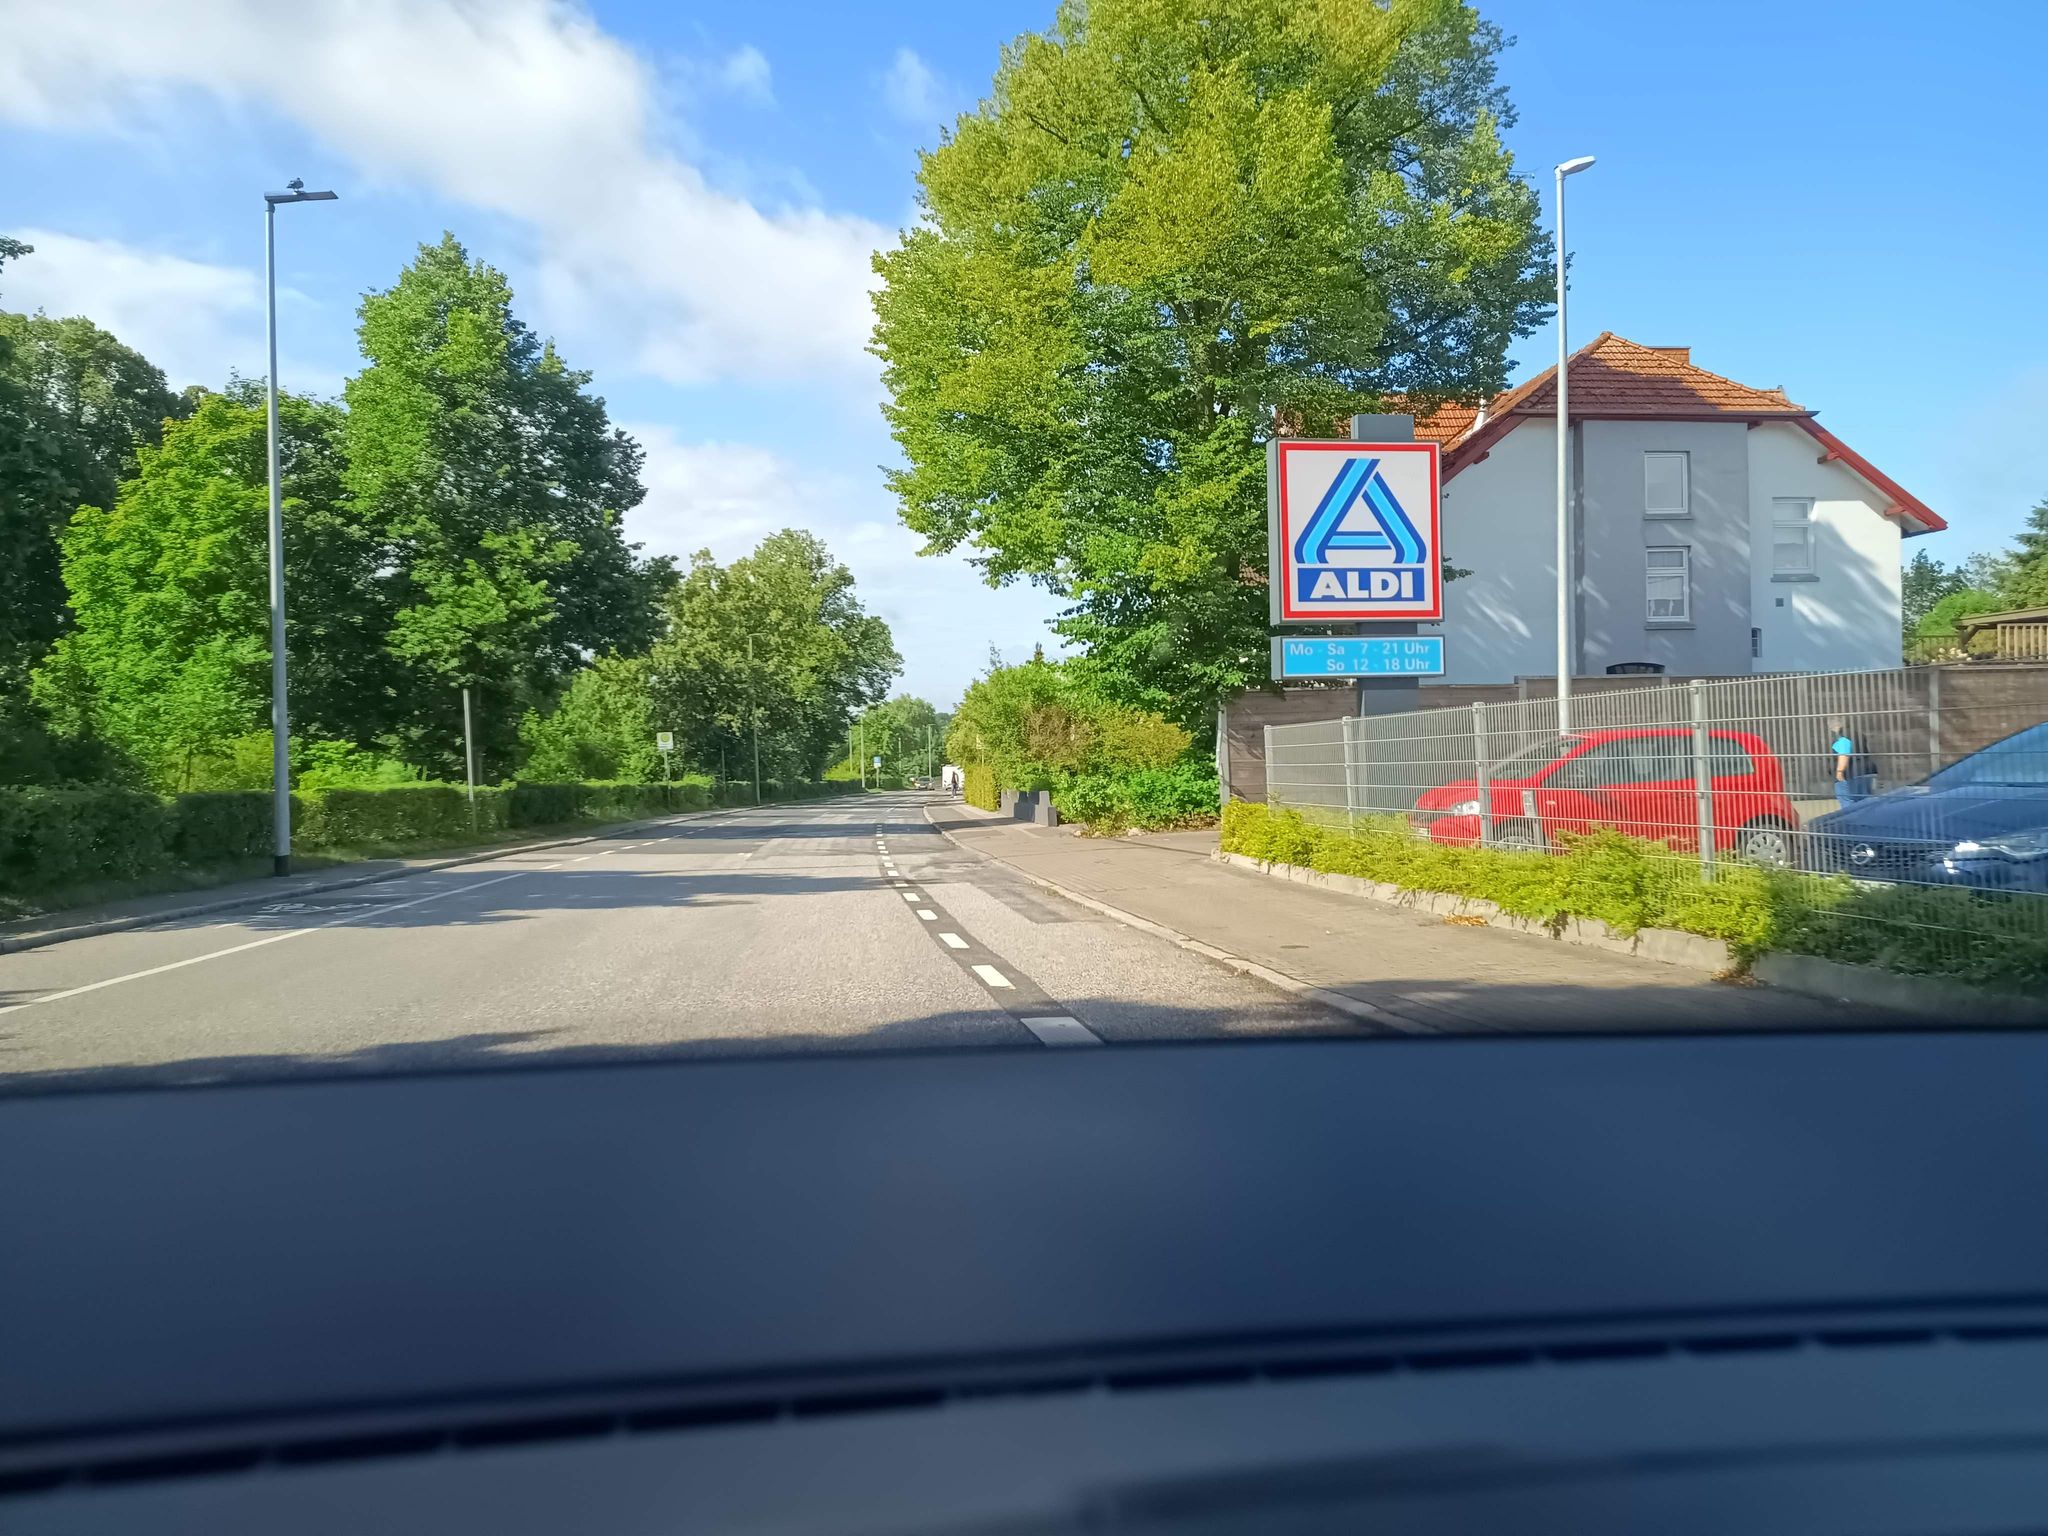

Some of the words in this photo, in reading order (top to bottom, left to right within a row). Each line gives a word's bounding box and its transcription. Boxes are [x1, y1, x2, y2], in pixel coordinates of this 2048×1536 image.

[1309, 571, 1414, 599] ALDI
[1290, 643, 1313, 655] Mo
[1327, 643, 1345, 655] Sa
[1361, 643, 1368, 655] 7
[1382, 642, 1398, 654] 21
[1404, 642, 1429, 654] Uhr
[1327, 659, 1345, 671] So
[1353, 659, 1368, 671] 12
[1384, 658, 1400, 670] 18
[1404, 658, 1430, 670] Uhr
